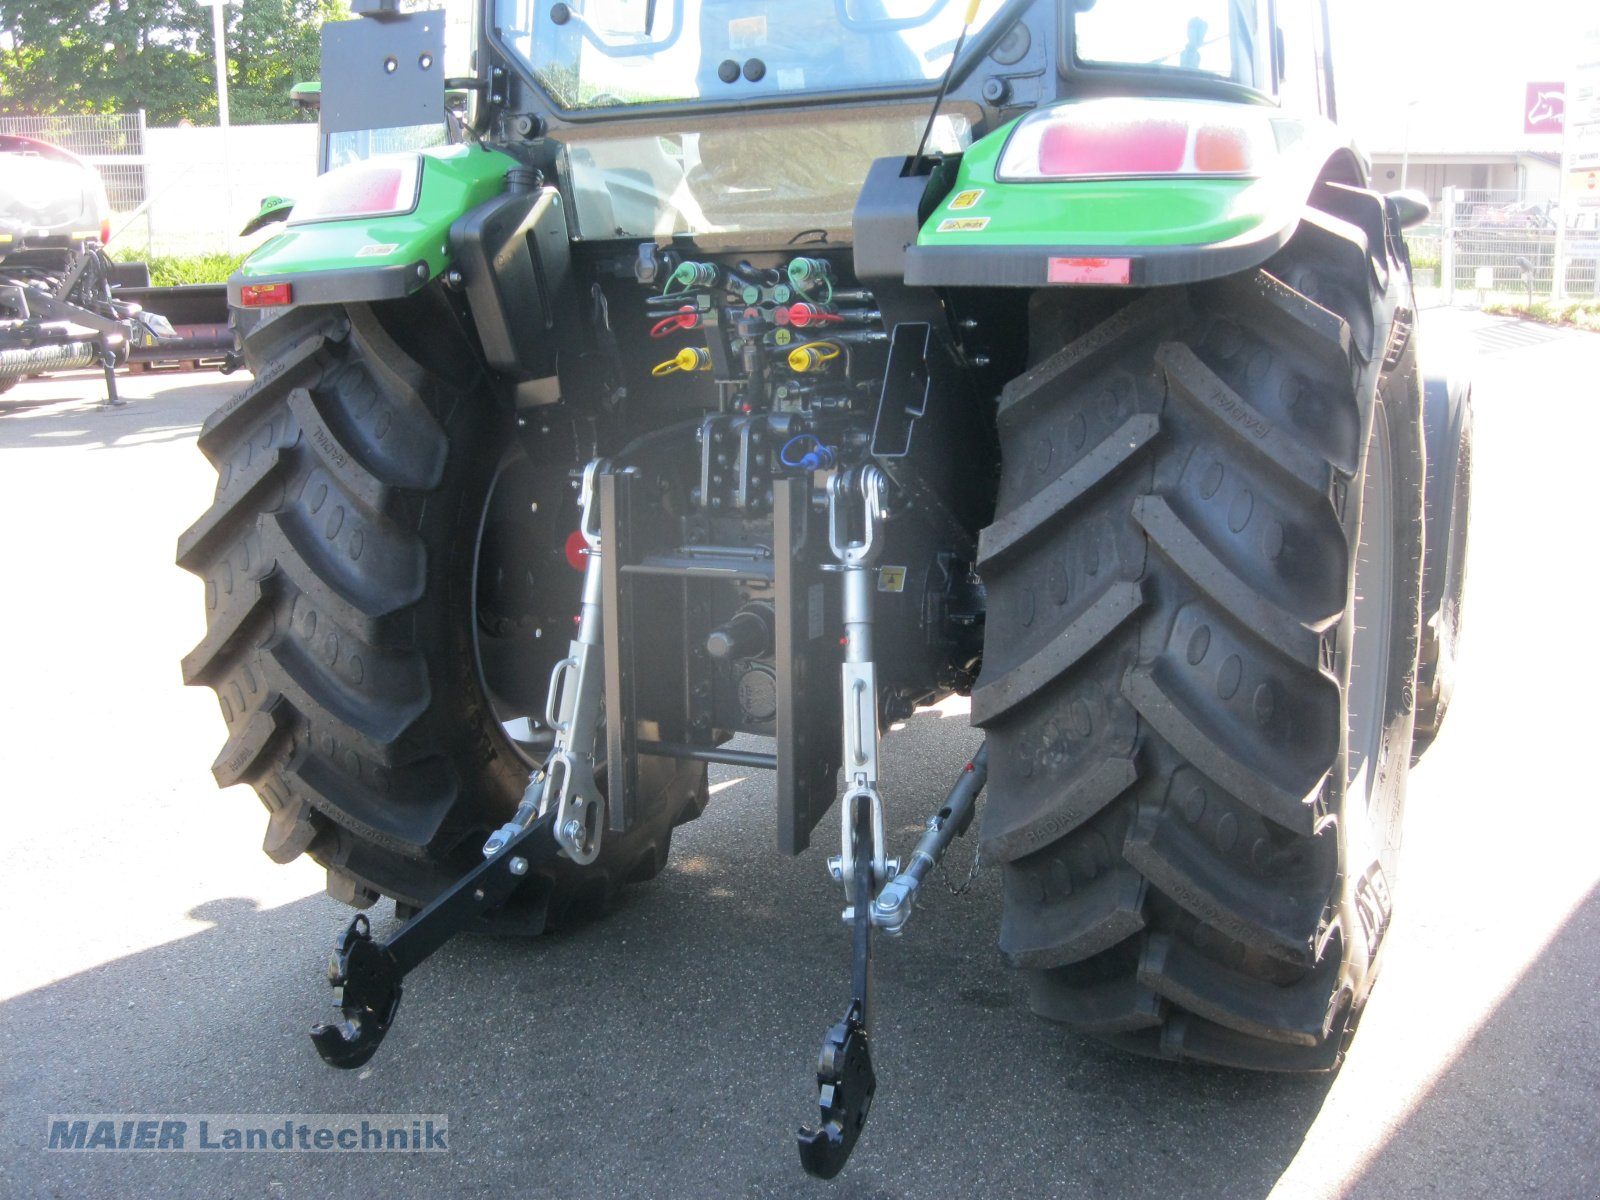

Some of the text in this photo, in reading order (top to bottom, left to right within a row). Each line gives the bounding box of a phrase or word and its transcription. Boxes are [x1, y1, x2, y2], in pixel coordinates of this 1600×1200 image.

[1209, 386, 1271, 438] RADIAL
[313, 423, 349, 471] RADIAL
[1025, 808, 1081, 843] RADIAL
